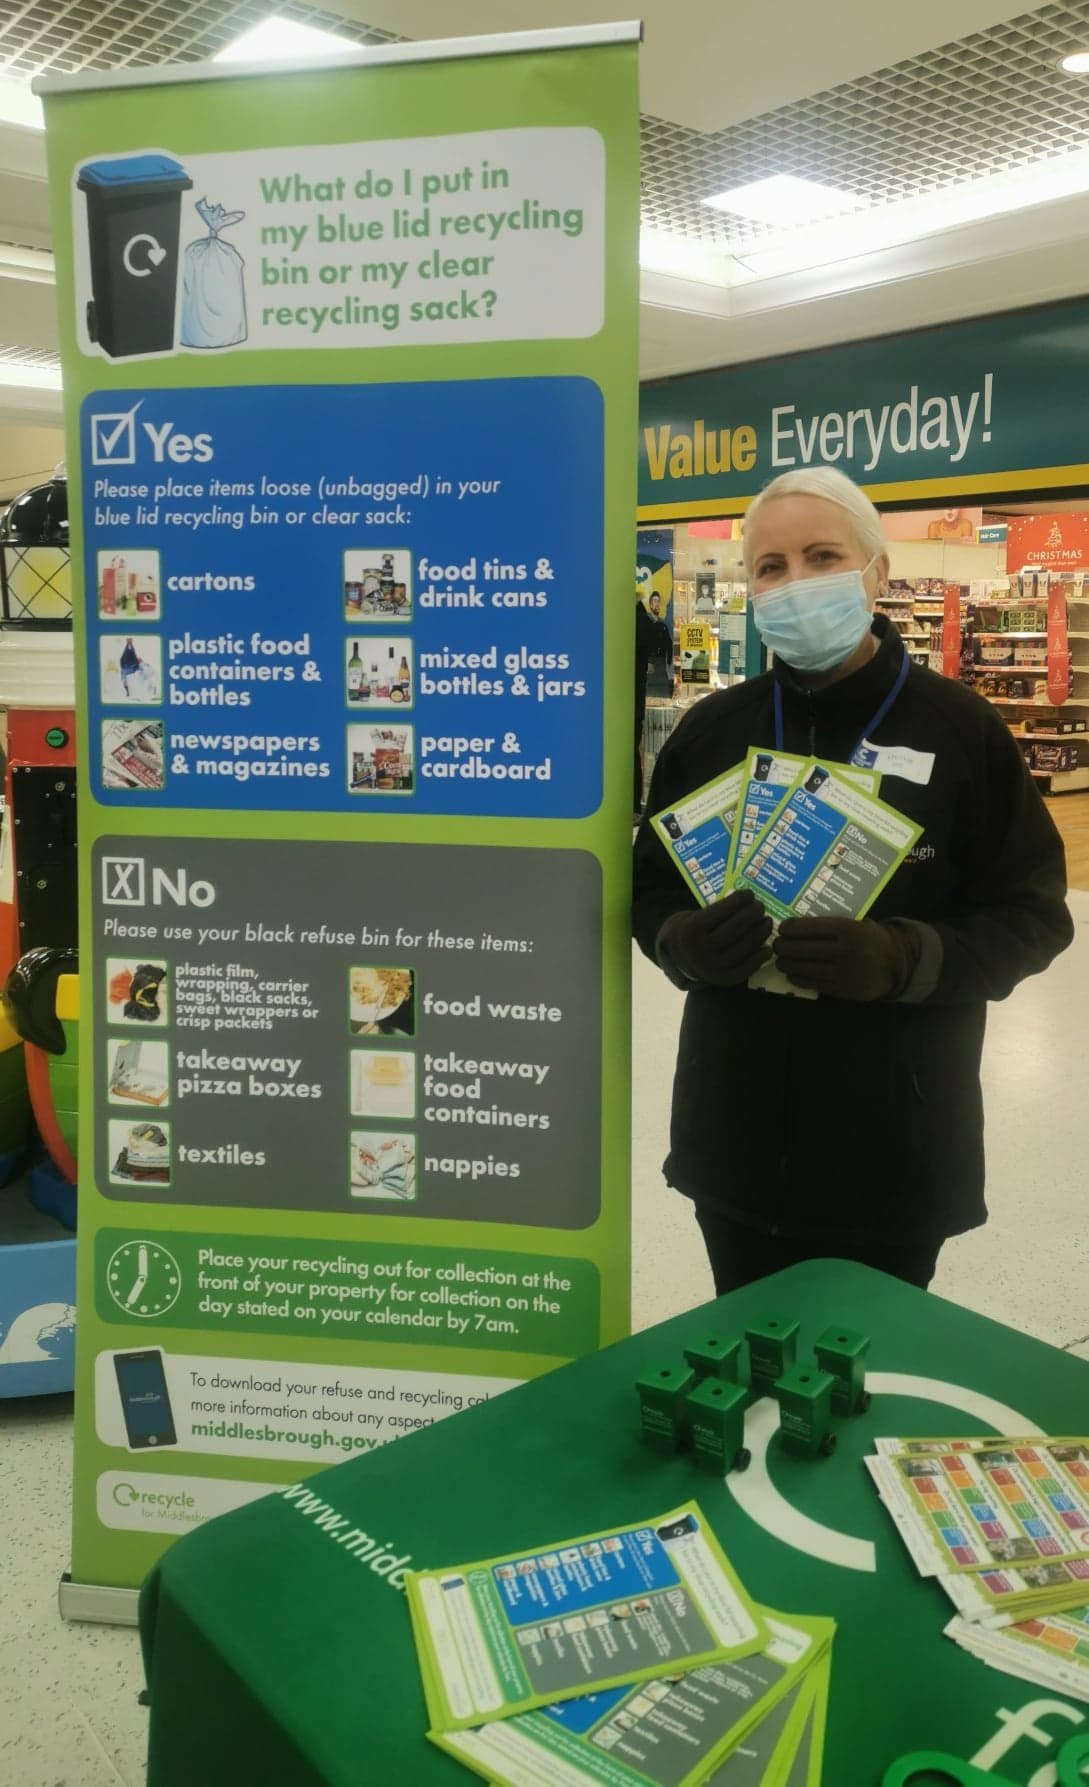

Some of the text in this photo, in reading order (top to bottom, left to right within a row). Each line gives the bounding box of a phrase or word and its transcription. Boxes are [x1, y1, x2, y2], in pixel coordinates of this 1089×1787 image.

[260, 161, 509, 203] What do I put in
[261, 201, 584, 251] my blue lid recycling
[261, 252, 494, 288] bin or my clear
[262, 291, 498, 333] recycling sack?
[644, 373, 993, 480] Value Everyday!
[144, 422, 213, 463] Yes
[94, 475, 500, 501] Please place items loose (unbagged) in your
[95, 506, 412, 528] blue lid recycling bin or clear sack:
[1027, 550, 1082, 561] CHRISTMAS
[418, 558, 554, 581] food tins &
[167, 572, 255, 592] cartons
[419, 586, 547, 608] drink cans
[687, 628, 704, 638] CCTV
[169, 633, 309, 660] plastic food
[169, 662, 321, 682] containers &
[420, 647, 569, 673] mixed glass
[170, 685, 250, 706] bottles
[421, 675, 586, 701] bottles & jars
[171, 732, 320, 755] newspapers
[421, 733, 520, 757] paper &
[171, 756, 330, 781] & magazines
[421, 758, 551, 781] cardboard
[761, 786, 774, 797] Yes
[804, 798, 816, 811] Yes
[855, 831, 868, 844] No
[909, 845, 934, 860] ugh
[152, 868, 215, 907] No
[104, 919, 533, 953] Please use your black refuse bin for these items:
[176, 963, 258, 980] plastic film,
[176, 978, 309, 994] wrapping, carrier
[176, 989, 312, 1007] bags, black sacks,
[176, 1004, 318, 1020] sweet wrappers or
[424, 994, 562, 1022] food waste
[176, 1016, 272, 1031] crisp packets
[177, 1051, 301, 1077] takeaway
[424, 1055, 549, 1084] takeaway
[177, 1076, 321, 1099] pizza boxes
[424, 1078, 480, 1099] food
[424, 1105, 550, 1130] containers
[178, 1144, 265, 1166] textiles
[424, 1156, 520, 1180] nappies
[198, 1249, 571, 1292] Place your recycling out for collection at the
[198, 1272, 560, 1314] front of your property for collection on the
[199, 1296, 519, 1335] day stated on your calendar by 7am.
[190, 1372, 206, 1388] To
[211, 1373, 281, 1392] download
[285, 1380, 316, 1398] your
[321, 1377, 363, 1397] refuse
[368, 1381, 394, 1401] and
[400, 1383, 462, 1409] recycling
[190, 1398, 434, 1432] more information about any aspect
[141, 1489, 195, 1510] recycle
